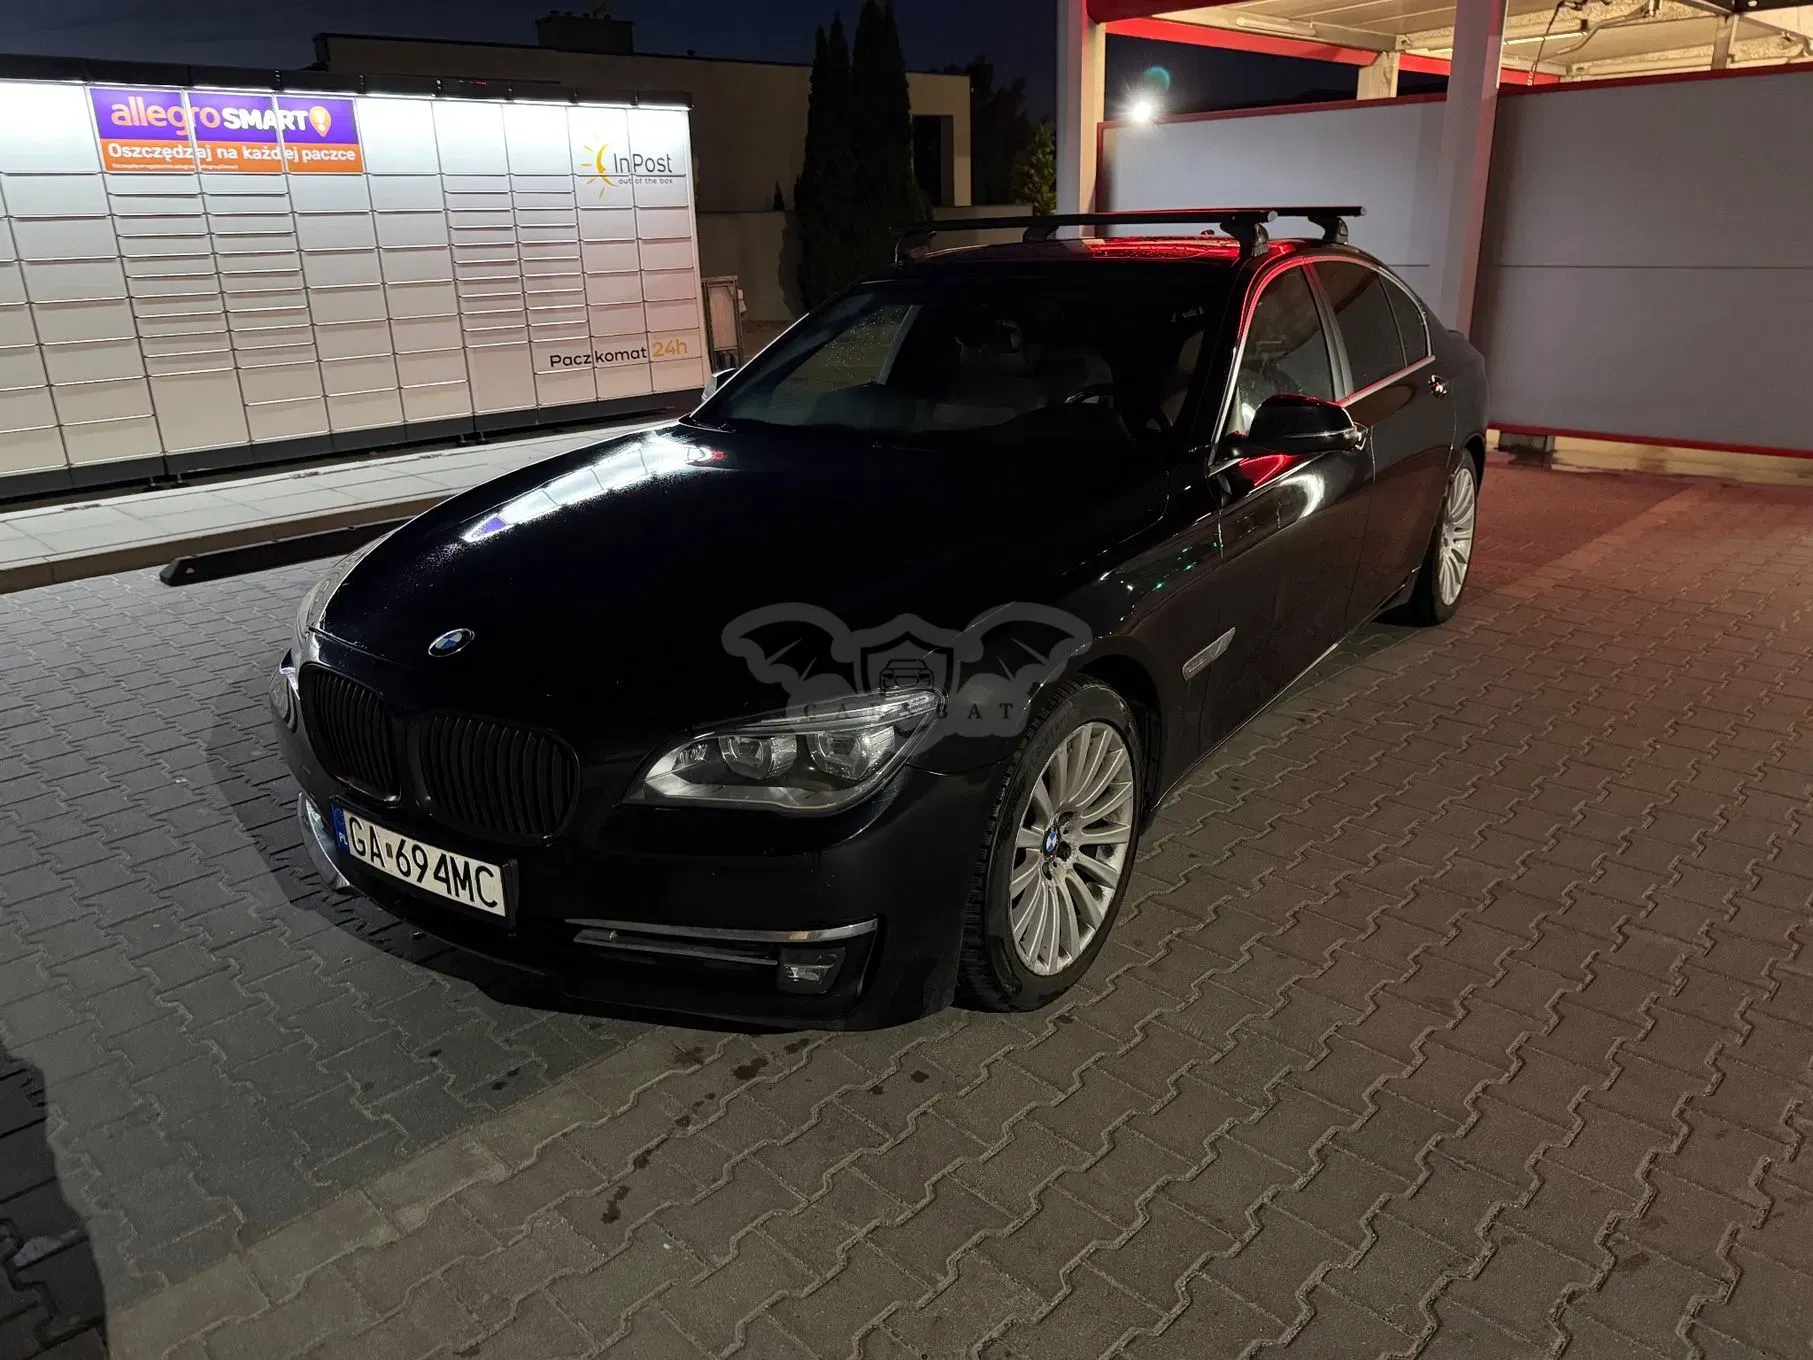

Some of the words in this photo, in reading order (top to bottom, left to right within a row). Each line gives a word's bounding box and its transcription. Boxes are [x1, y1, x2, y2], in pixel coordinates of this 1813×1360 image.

[111, 96, 221, 136] allegro
[108, 143, 213, 162] Oszczędzaj
[217, 147, 238, 159] na
[242, 145, 299, 163] każdej
[302, 148, 356, 163] paczce
[613, 153, 673, 173] InPost
[550, 346, 648, 367] Paczkomat
[652, 338, 688, 358] 24h
